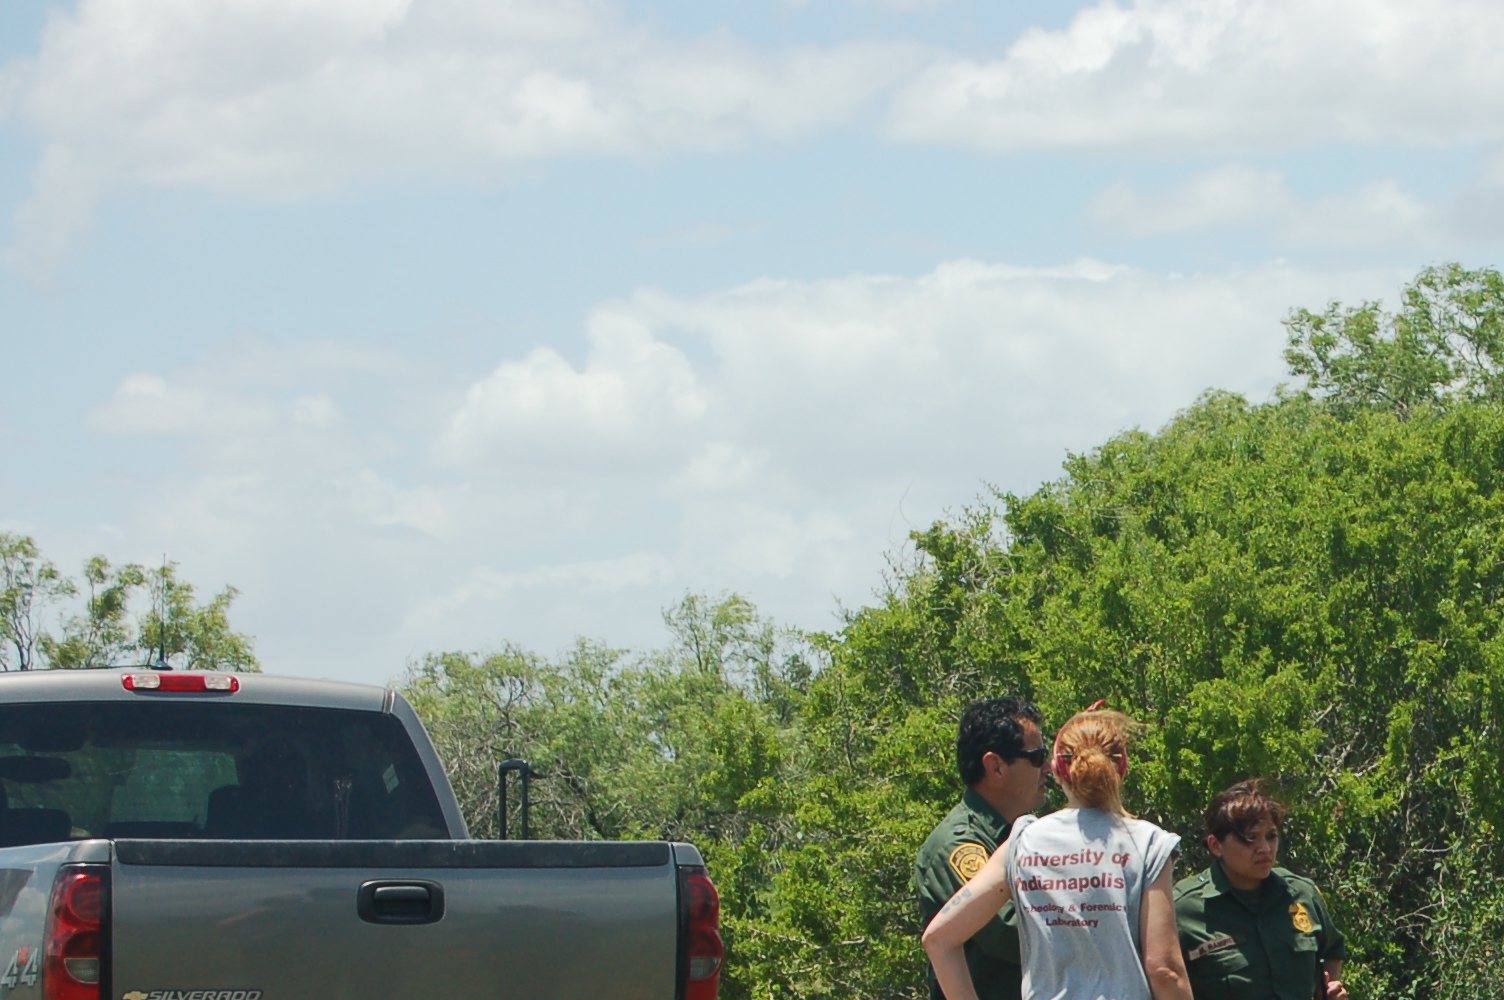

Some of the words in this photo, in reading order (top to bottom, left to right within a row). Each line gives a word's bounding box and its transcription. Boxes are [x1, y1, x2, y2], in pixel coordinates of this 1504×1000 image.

[1111, 852, 1131, 868] of
[1023, 902, 1065, 914] heology
[1068, 904, 1078, 913] &
